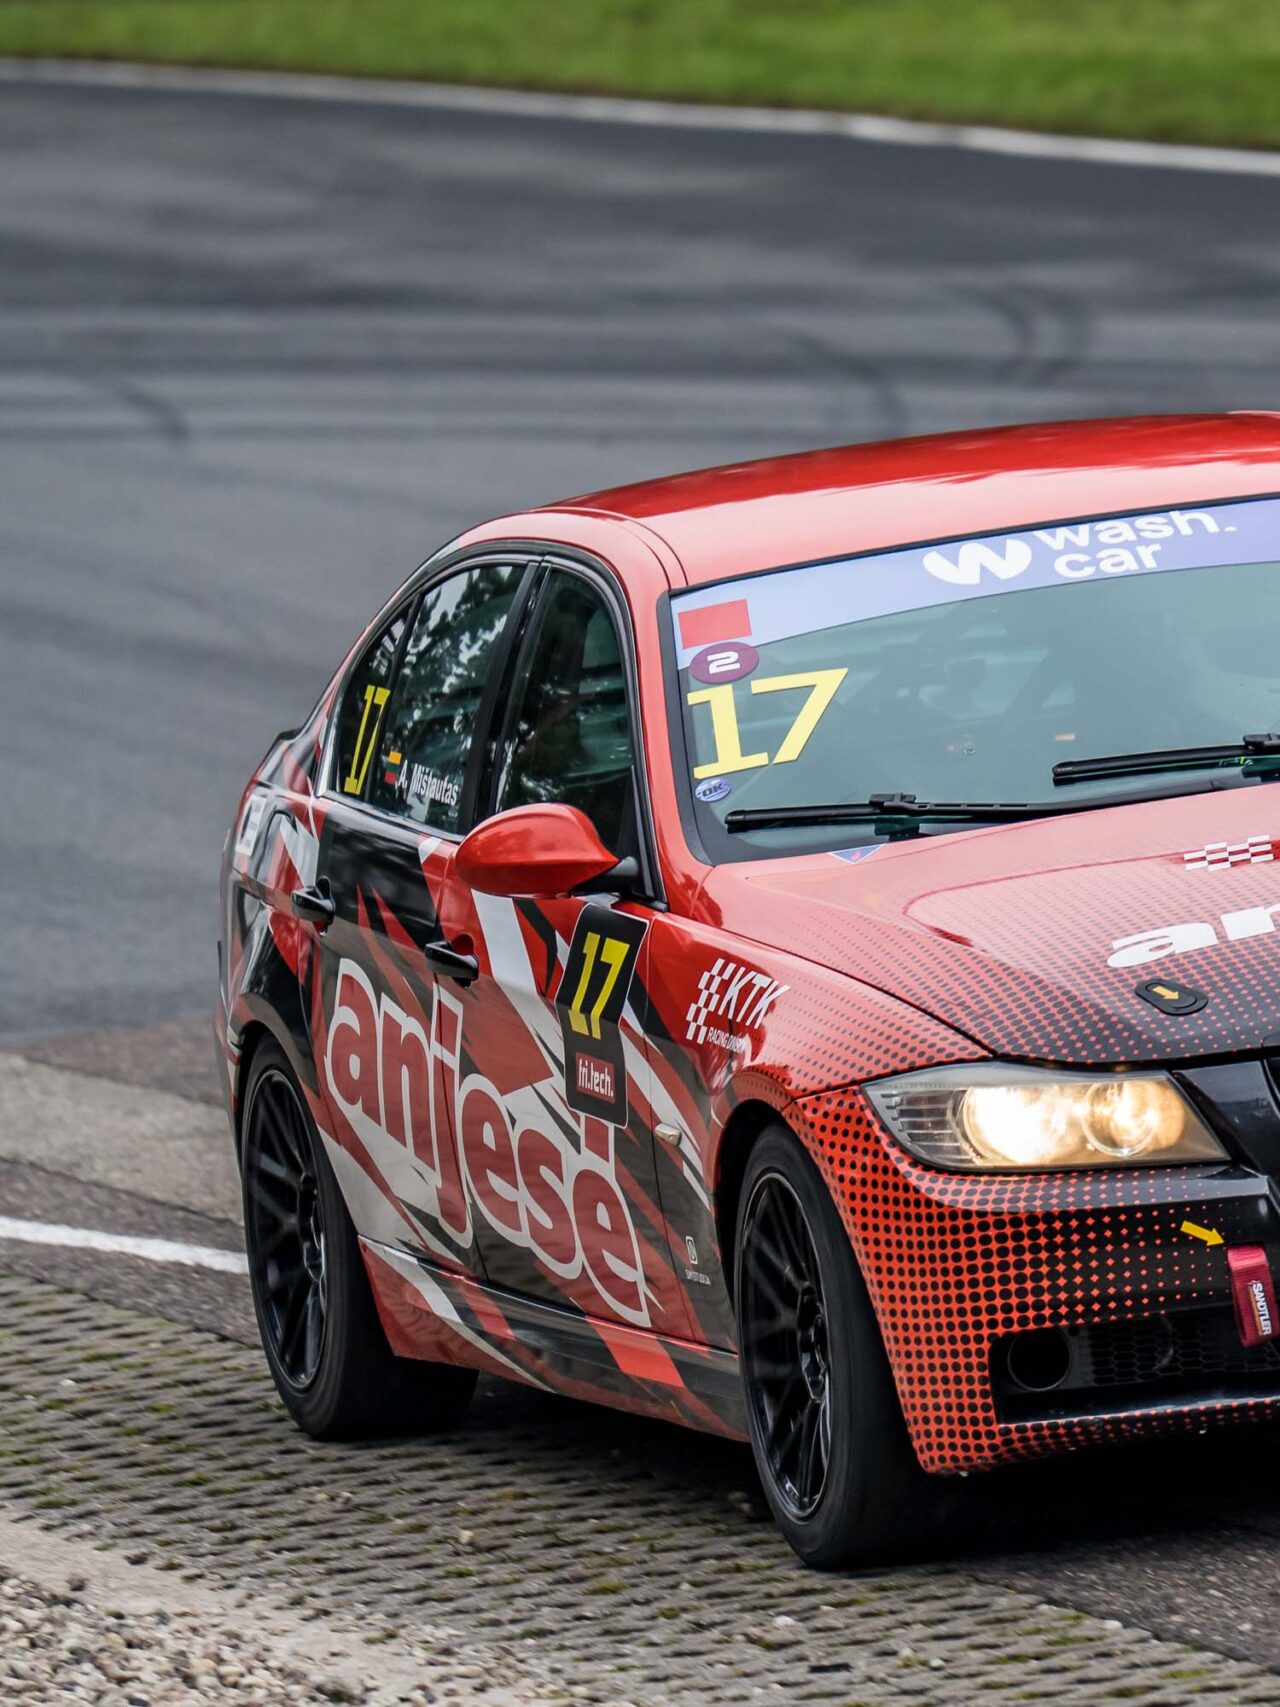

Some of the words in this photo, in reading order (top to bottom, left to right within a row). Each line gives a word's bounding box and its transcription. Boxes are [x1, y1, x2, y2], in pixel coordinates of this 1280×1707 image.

[1053, 543, 1162, 579] car
[707, 650, 741, 674] 2
[344, 684, 391, 795] 17
[687, 667, 849, 780] 17
[566, 931, 631, 1040] 17
[717, 966, 792, 1030] KTK
[1252, 1282, 1273, 1336] SANDTLER
